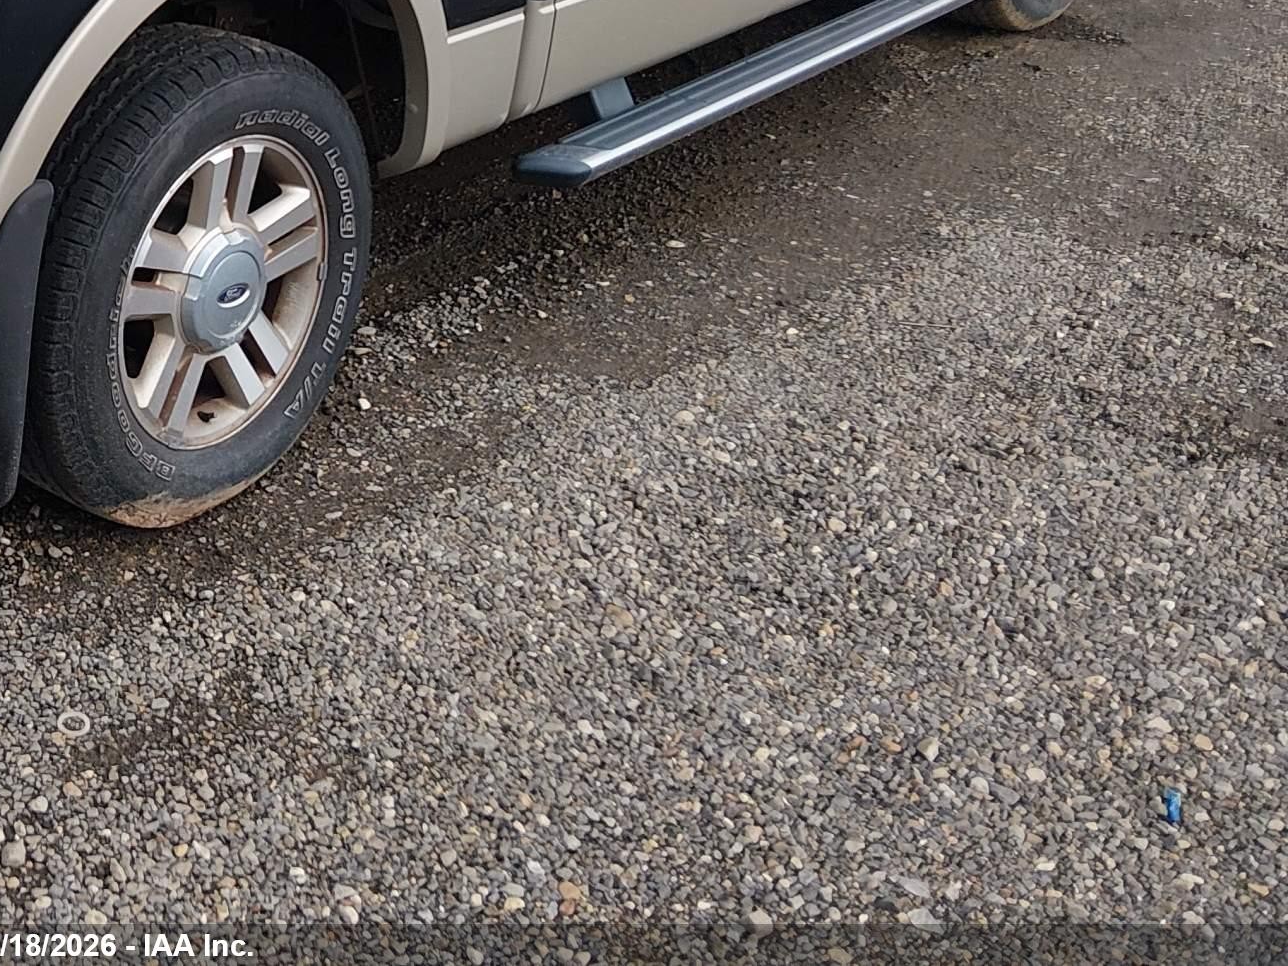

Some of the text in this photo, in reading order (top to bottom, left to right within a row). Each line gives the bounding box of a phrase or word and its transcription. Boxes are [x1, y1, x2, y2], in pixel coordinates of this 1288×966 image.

[235, 109, 358, 419] Radial Long Trail T/A
